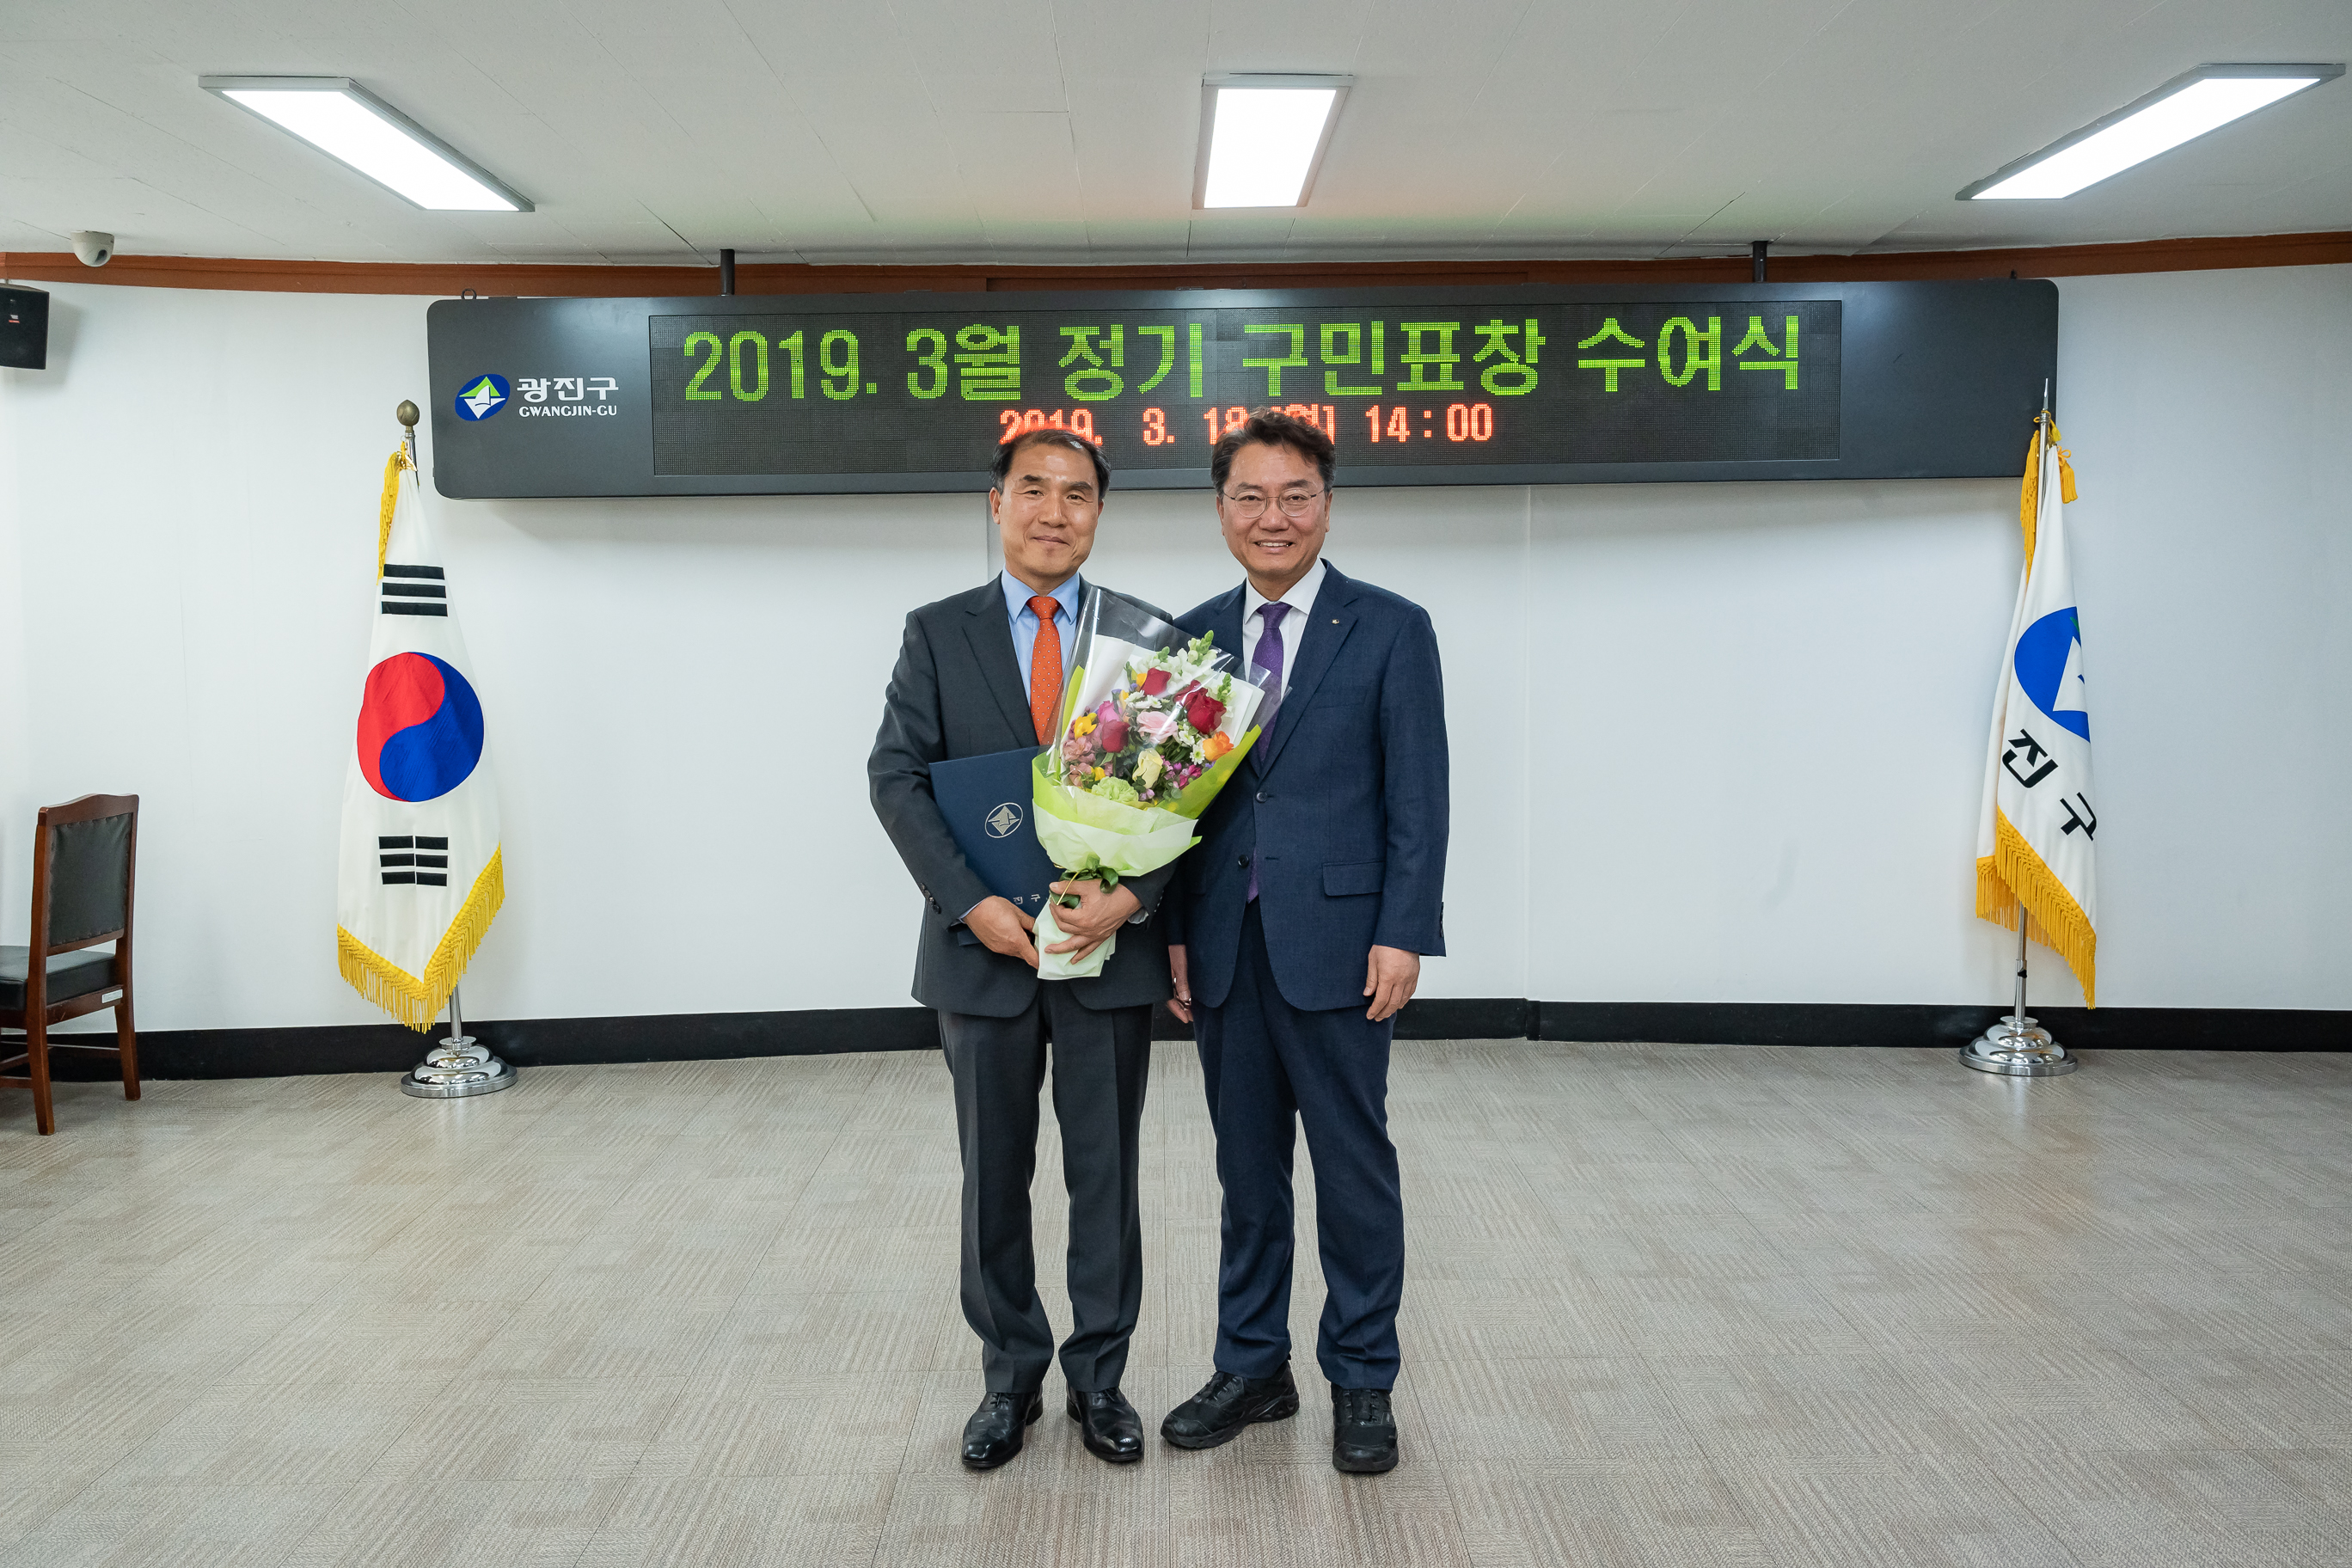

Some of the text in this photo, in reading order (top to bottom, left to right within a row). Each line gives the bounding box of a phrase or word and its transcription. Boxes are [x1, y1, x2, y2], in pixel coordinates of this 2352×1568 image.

[683, 315, 1798, 401] 2019. 3월 정기 구민표창 수여식
[517, 377, 619, 403] 광진구
[518, 405, 617, 417] GWANGJIN-GU
[1142, 407, 1175, 446] 3.
